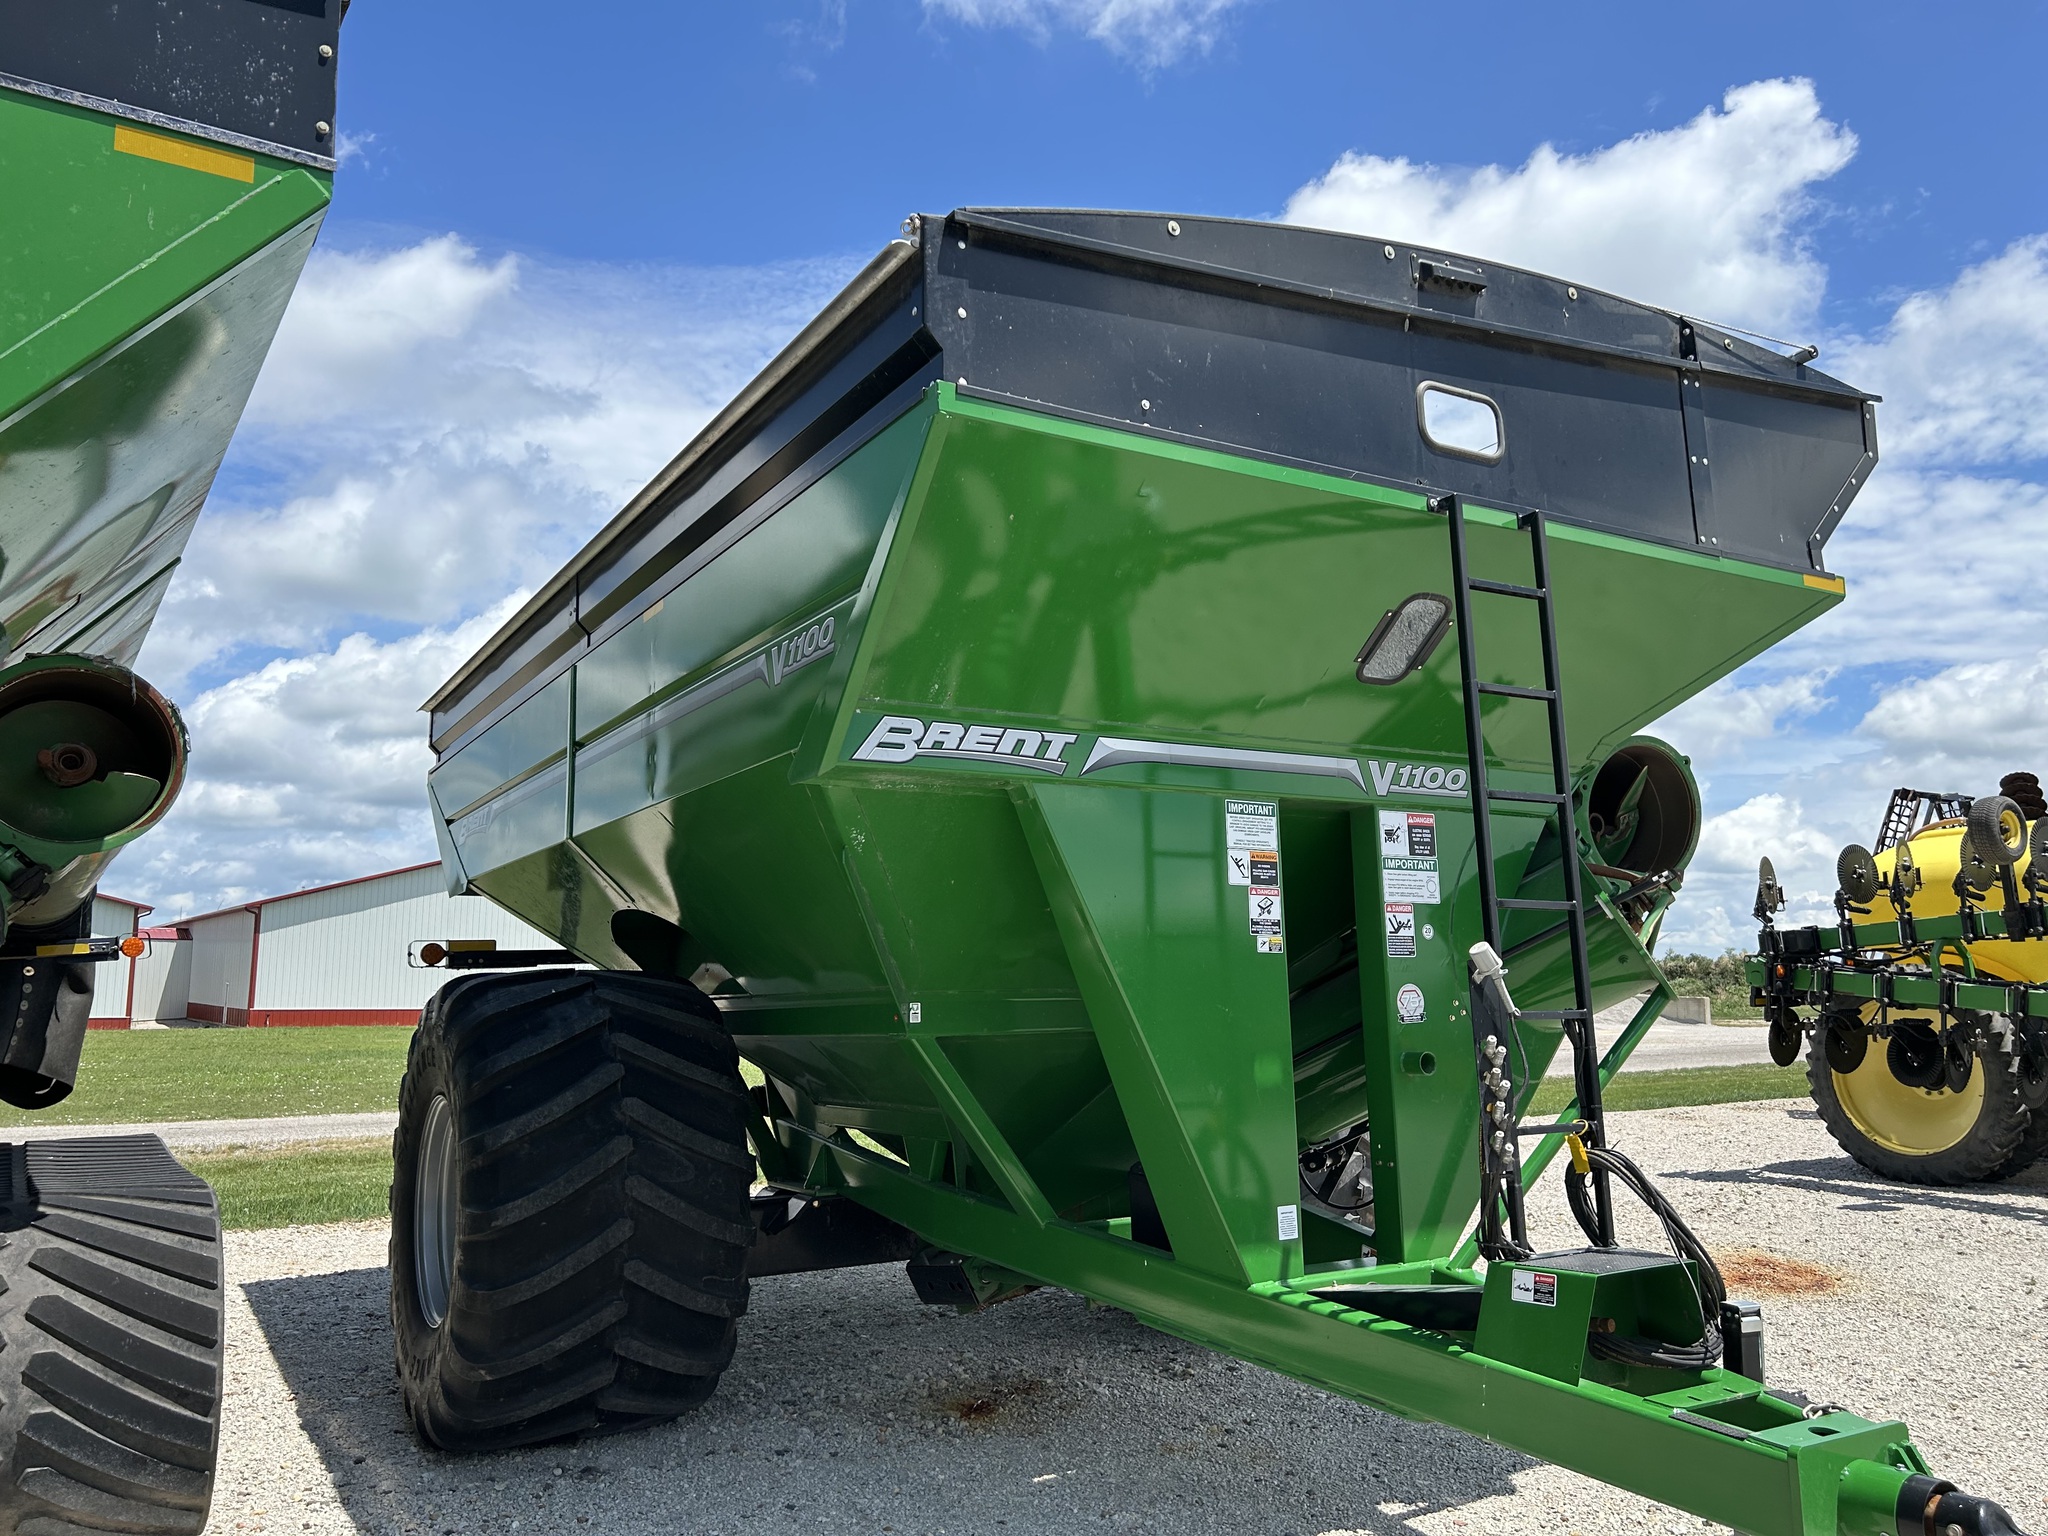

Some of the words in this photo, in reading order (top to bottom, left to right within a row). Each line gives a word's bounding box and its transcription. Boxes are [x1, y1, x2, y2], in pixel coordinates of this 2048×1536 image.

[771, 616, 835, 686] V1100
[851, 715, 1078, 763] BRENT
[1368, 760, 1467, 796] V1100
[1228, 802, 1274, 816] IMPORTANT
[1412, 816, 1434, 824] DANGER
[1385, 858, 1435, 870] IMPORTANT
[1256, 888, 1279, 896] DANGER
